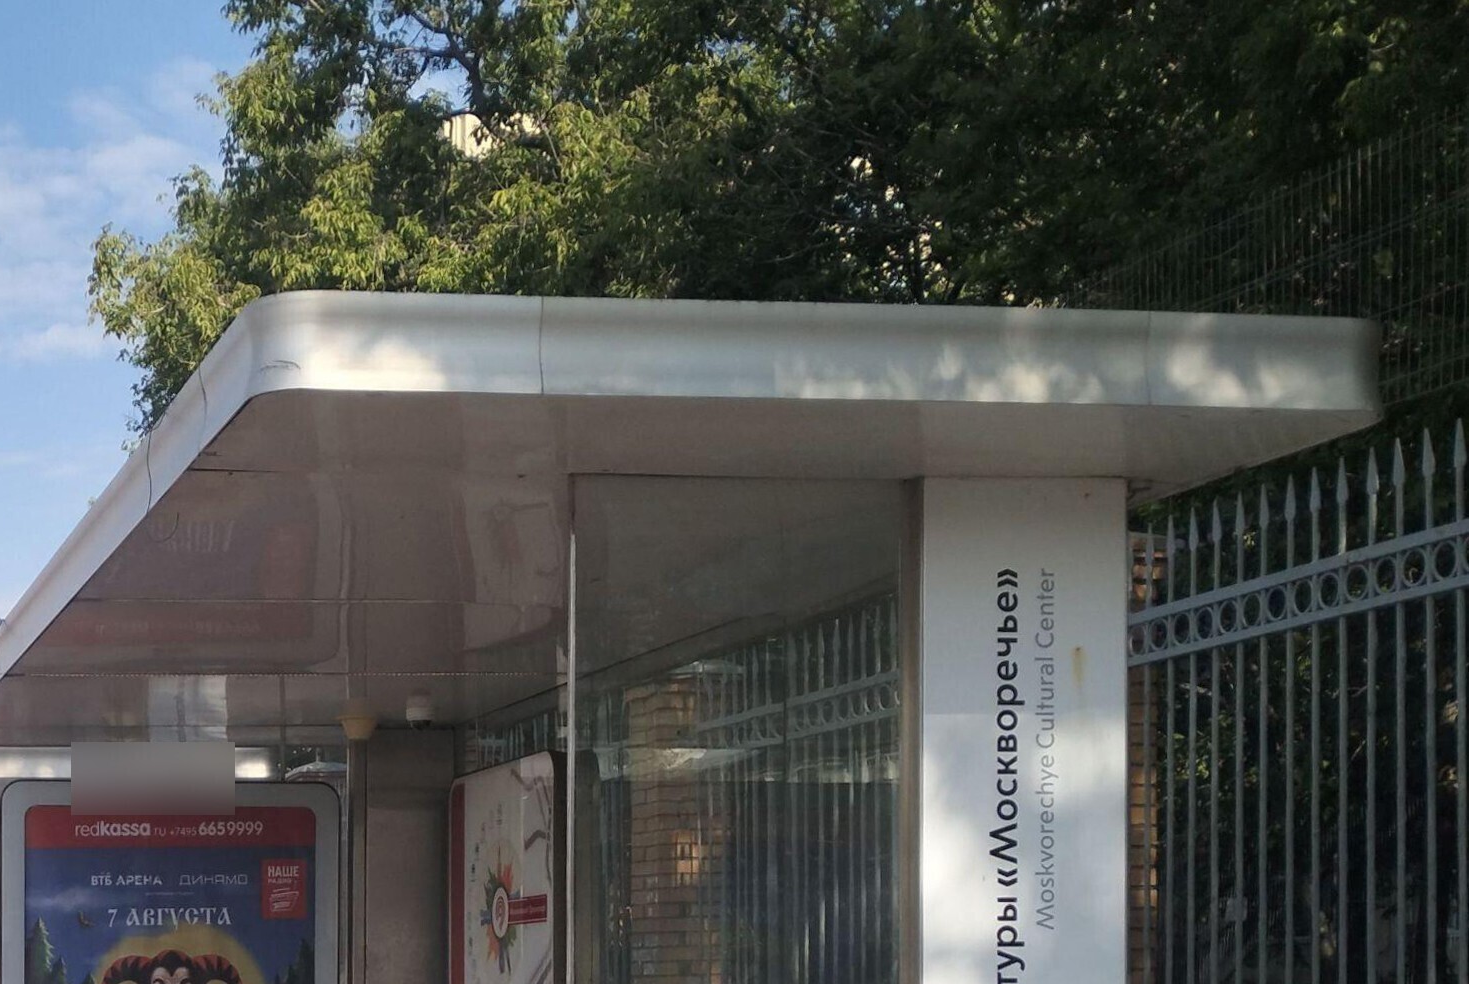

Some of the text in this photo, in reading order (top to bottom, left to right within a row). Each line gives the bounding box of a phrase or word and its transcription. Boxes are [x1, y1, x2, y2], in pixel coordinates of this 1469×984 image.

[988, 567, 1026, 887] «Москворечье»
[1034, 567, 1060, 930] Moskvorechye Cultural Center
[91, 872, 249, 887] ВТБ АРЕНА ДИНАМО
[267, 865, 300, 878] НАШЕ
[107, 906, 232, 930] 7 АВГУСТА
